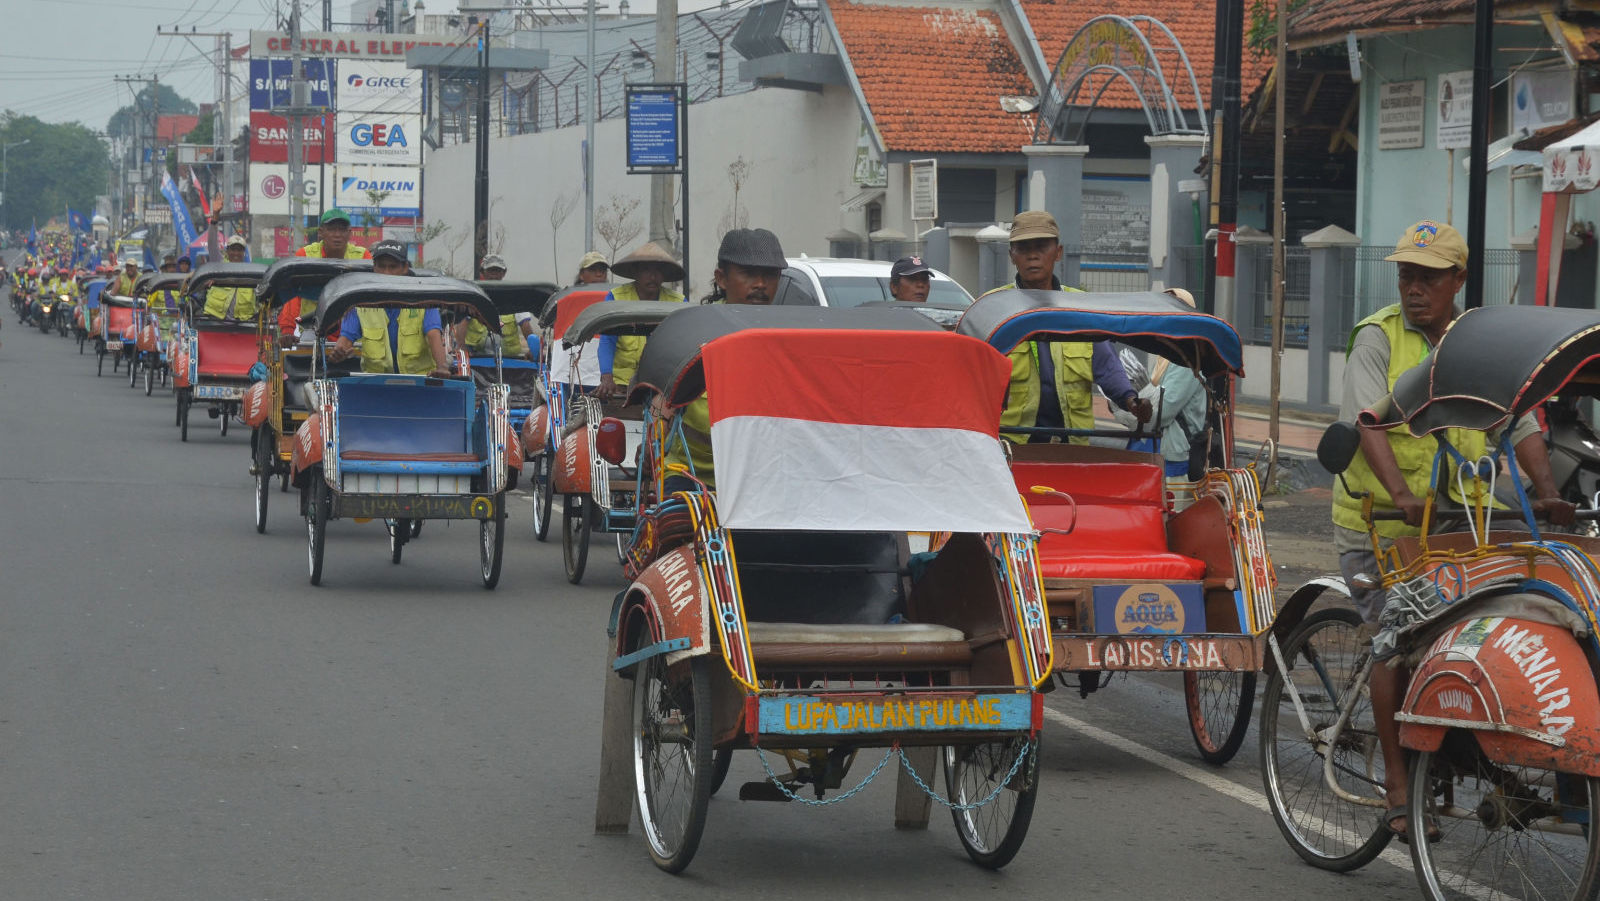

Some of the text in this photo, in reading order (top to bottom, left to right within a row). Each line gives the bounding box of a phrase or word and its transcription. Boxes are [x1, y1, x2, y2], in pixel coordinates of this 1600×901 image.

[255, 78, 328, 91] SAMNG
[366, 76, 411, 88] GREE
[258, 127, 326, 141] SANEN
[350, 123, 408, 148] GEA
[356, 180, 415, 191] DAIKIN
[1121, 605, 1179, 625] AQUA
[1492, 624, 1576, 736] MENARA
[1437, 690, 1473, 715] KUDUS
[841, 699, 915, 729] JALAN
